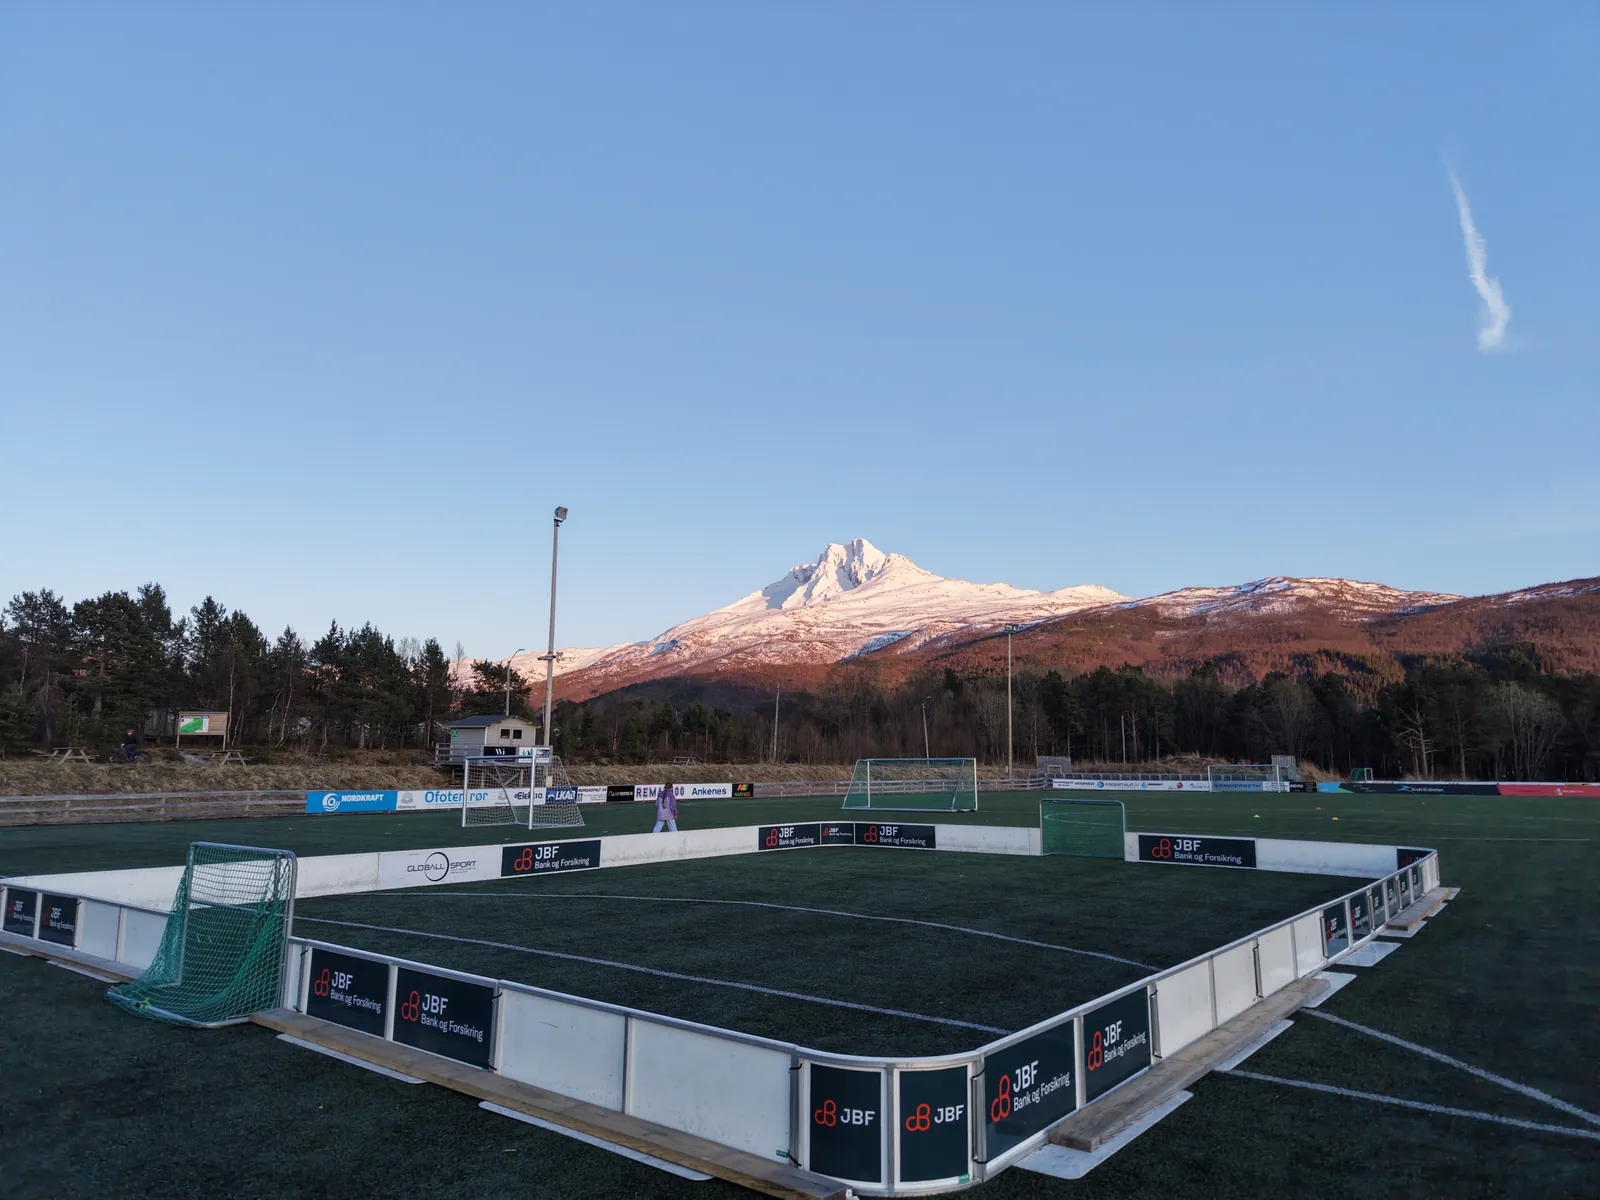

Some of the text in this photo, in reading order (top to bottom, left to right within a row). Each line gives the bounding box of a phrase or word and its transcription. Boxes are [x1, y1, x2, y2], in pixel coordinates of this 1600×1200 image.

[341, 794, 384, 802] NORDKRAFT
[692, 787, 726, 796] Ankenes
[779, 827, 794, 838] JBF
[880, 826, 898, 836] JBF
[900, 838, 926, 846] Forsikring
[1174, 839, 1201, 851] JBF
[535, 846, 560, 860] JBF
[1204, 854, 1242, 864] Forsikring
[534, 857, 590, 869] Bank og Forsikring
[332, 971, 353, 990] JBF
[330, 989, 382, 1014] Bank og Forsikring
[422, 994, 448, 1015] JBF
[421, 1014, 483, 1042] Bank og Forsikring
[1104, 1020, 1122, 1046] JBF
[1104, 1031, 1146, 1062] Bank og Forsikring
[1013, 1060, 1039, 1092] JBF
[1014, 1072, 1070, 1111] Bank og Forsikring
[840, 1108, 875, 1126] JBF
[934, 1104, 964, 1124] JBF
